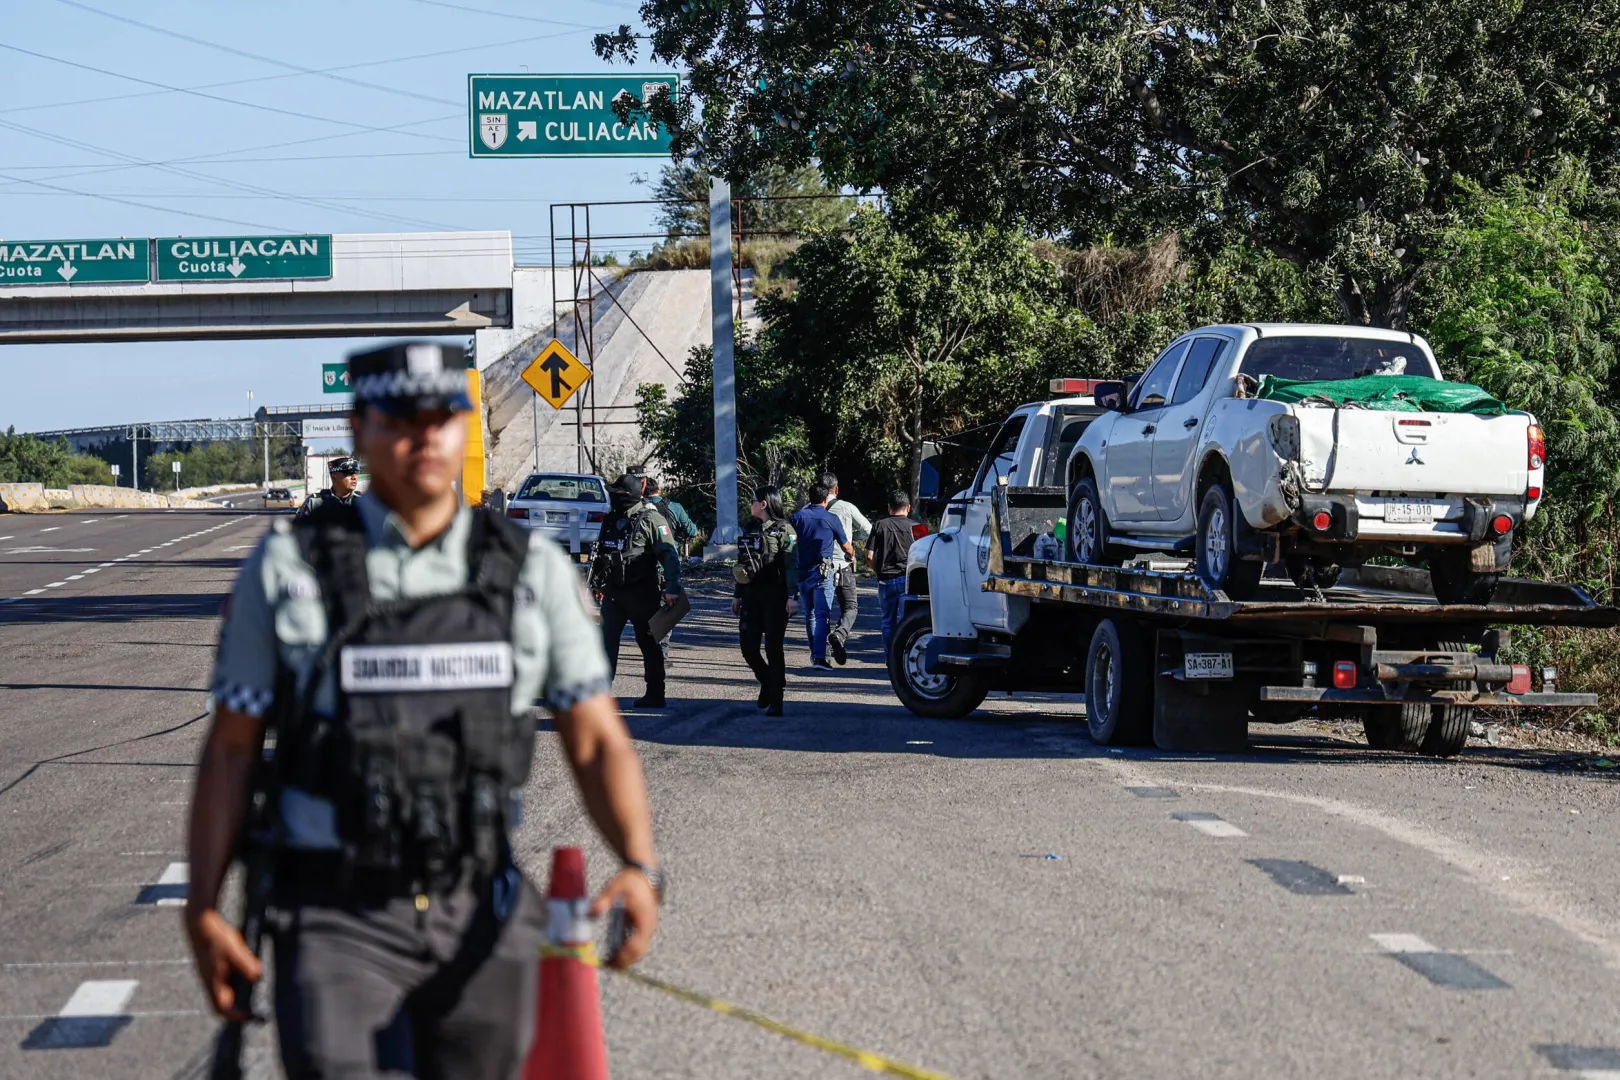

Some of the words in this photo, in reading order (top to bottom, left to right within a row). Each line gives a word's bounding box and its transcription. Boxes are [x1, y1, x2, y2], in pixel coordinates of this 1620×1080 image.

[478, 91, 604, 110] MAZATLAN
[486, 116, 501, 124] SIN
[491, 132, 496, 144] 1
[545, 121, 657, 141] CULIACAN
[170, 239, 318, 259] CULIACAN
[178, 260, 226, 274] Cuota
[1187, 658, 1232, 670] SA-387-A1
